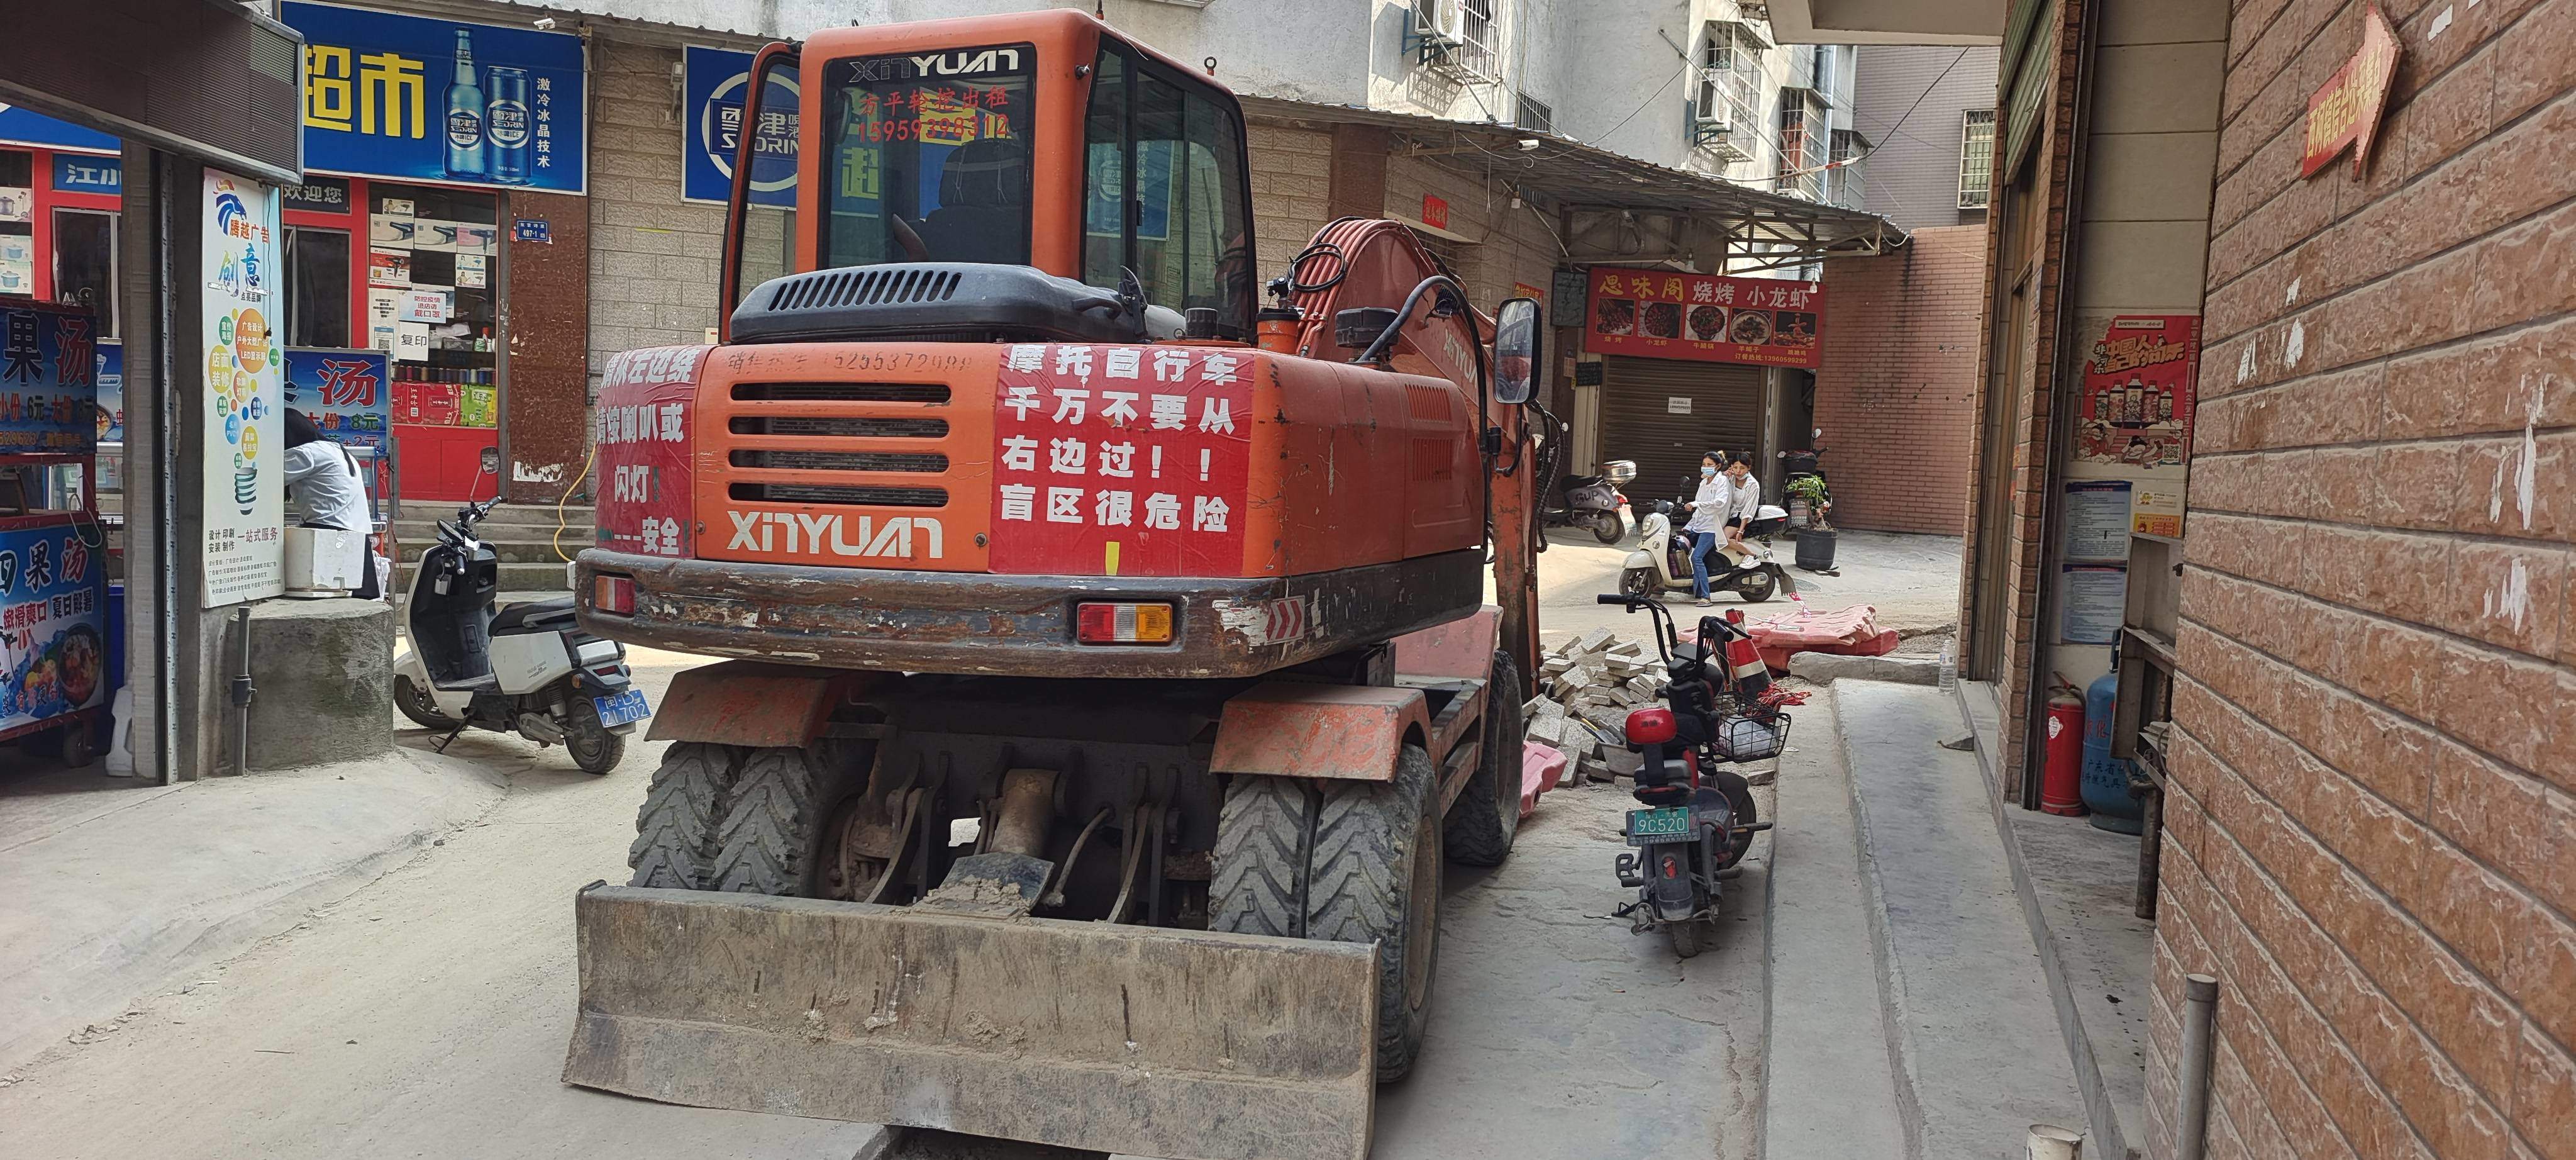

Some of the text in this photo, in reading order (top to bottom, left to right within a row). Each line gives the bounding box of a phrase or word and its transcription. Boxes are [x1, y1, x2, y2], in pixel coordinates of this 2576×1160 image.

[304, 43, 424, 139] 超市
[536, 77, 551, 168] 激冷冰晶技术
[284, 183, 343, 204] 欢迎您
[230, 219, 269, 244] 腾越广告
[218, 243, 260, 298] 创意
[241, 292, 262, 303] 点亮品牌
[1692, 281, 1735, 305] 烧烤
[1746, 285, 1809, 310] 小龙虾
[414, 310, 441, 318] 戴口罩
[242, 321, 263, 332] 广告设计
[401, 334, 427, 347] 复印
[2106, 333, 2153, 355] 中国人
[212, 352, 230, 368] 店面
[1007, 343, 1238, 386] 摩托自行车
[212, 371, 230, 388] 装修
[351, 412, 380, 431] 8元
[1004, 386, 1235, 435] 千万不要从
[596, 403, 684, 444] 请按喇叭或
[1000, 483, 1230, 533] 盲区很危险
[208, 527, 278, 544] 设计 印刷 一站式服务
[208, 540, 235, 554] 安装 制作
[52, 588, 94, 621] 夏日解暑
[602, 703, 648, 727] 21702
[1638, 818, 1685, 832] 9C520
